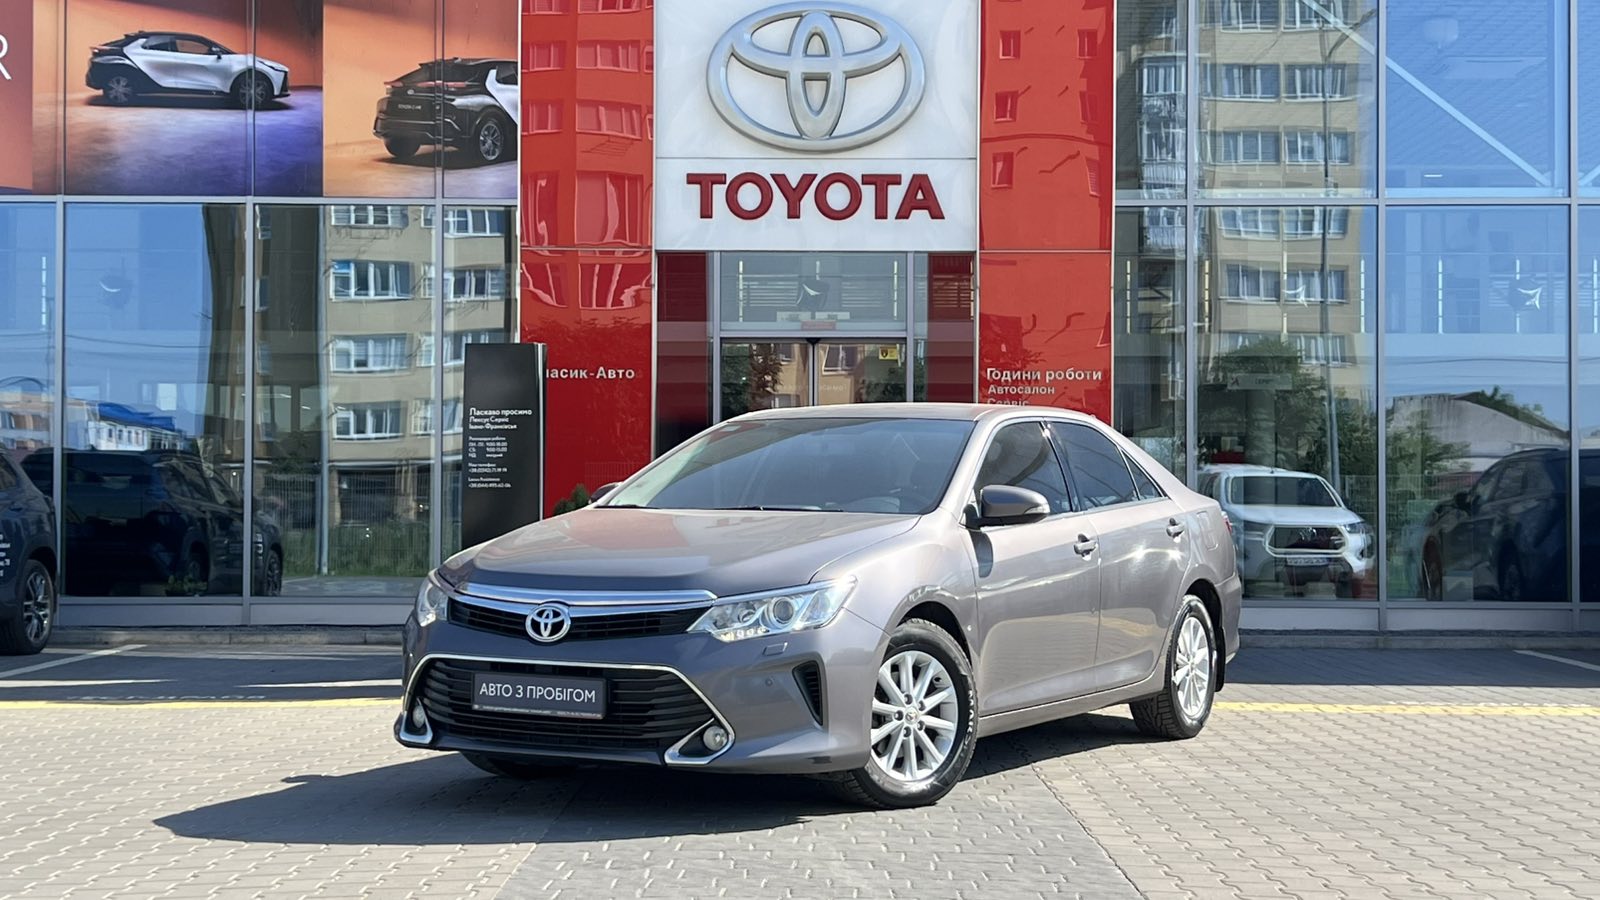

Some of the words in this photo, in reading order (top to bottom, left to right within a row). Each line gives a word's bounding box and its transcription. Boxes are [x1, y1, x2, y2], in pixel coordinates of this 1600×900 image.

[686, 172, 945, 221] TOYOTA
[546, 366, 635, 379] асик-Авто
[986, 367, 1041, 382] Години
[1046, 367, 1102, 383] роботи
[988, 384, 1055, 395] Автосалон
[501, 409, 533, 417] просимо
[479, 682, 513, 698] АВТО
[526, 685, 596, 703] ПРОБІГОМ
